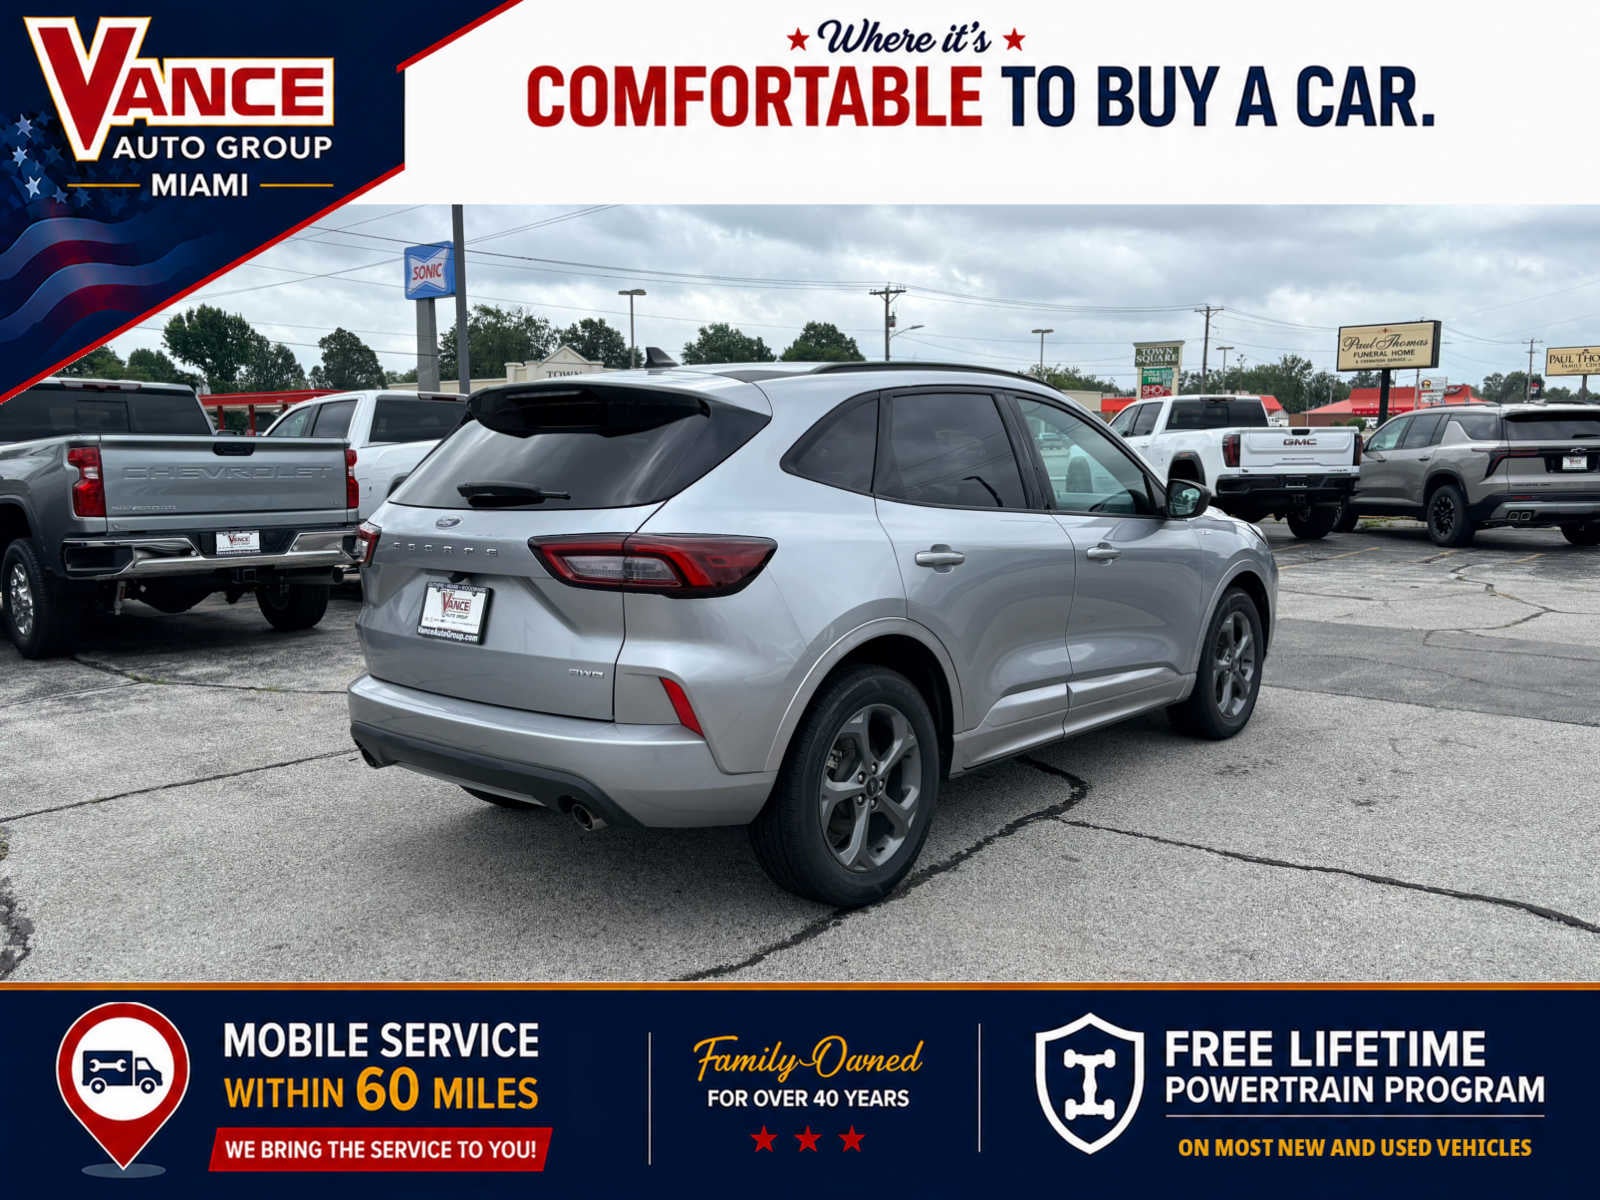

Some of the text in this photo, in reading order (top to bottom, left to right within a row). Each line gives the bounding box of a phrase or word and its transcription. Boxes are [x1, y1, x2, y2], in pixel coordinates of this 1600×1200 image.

[412, 263, 443, 281] SONIC
[1342, 333, 1428, 352] Paul Thomas
[1136, 354, 1179, 363] SQUARE
[1142, 347, 1173, 356] TOWN
[1353, 349, 1416, 358] FUNERAL HOME
[1549, 354, 1574, 364] PAUL
[1283, 438, 1317, 446] GMC
[122, 466, 333, 481] CHEVROLET
[393, 541, 497, 557] ESCAPE
[441, 590, 471, 615] VANCE
[418, 627, 478, 642] VanceAutoGroup.com
